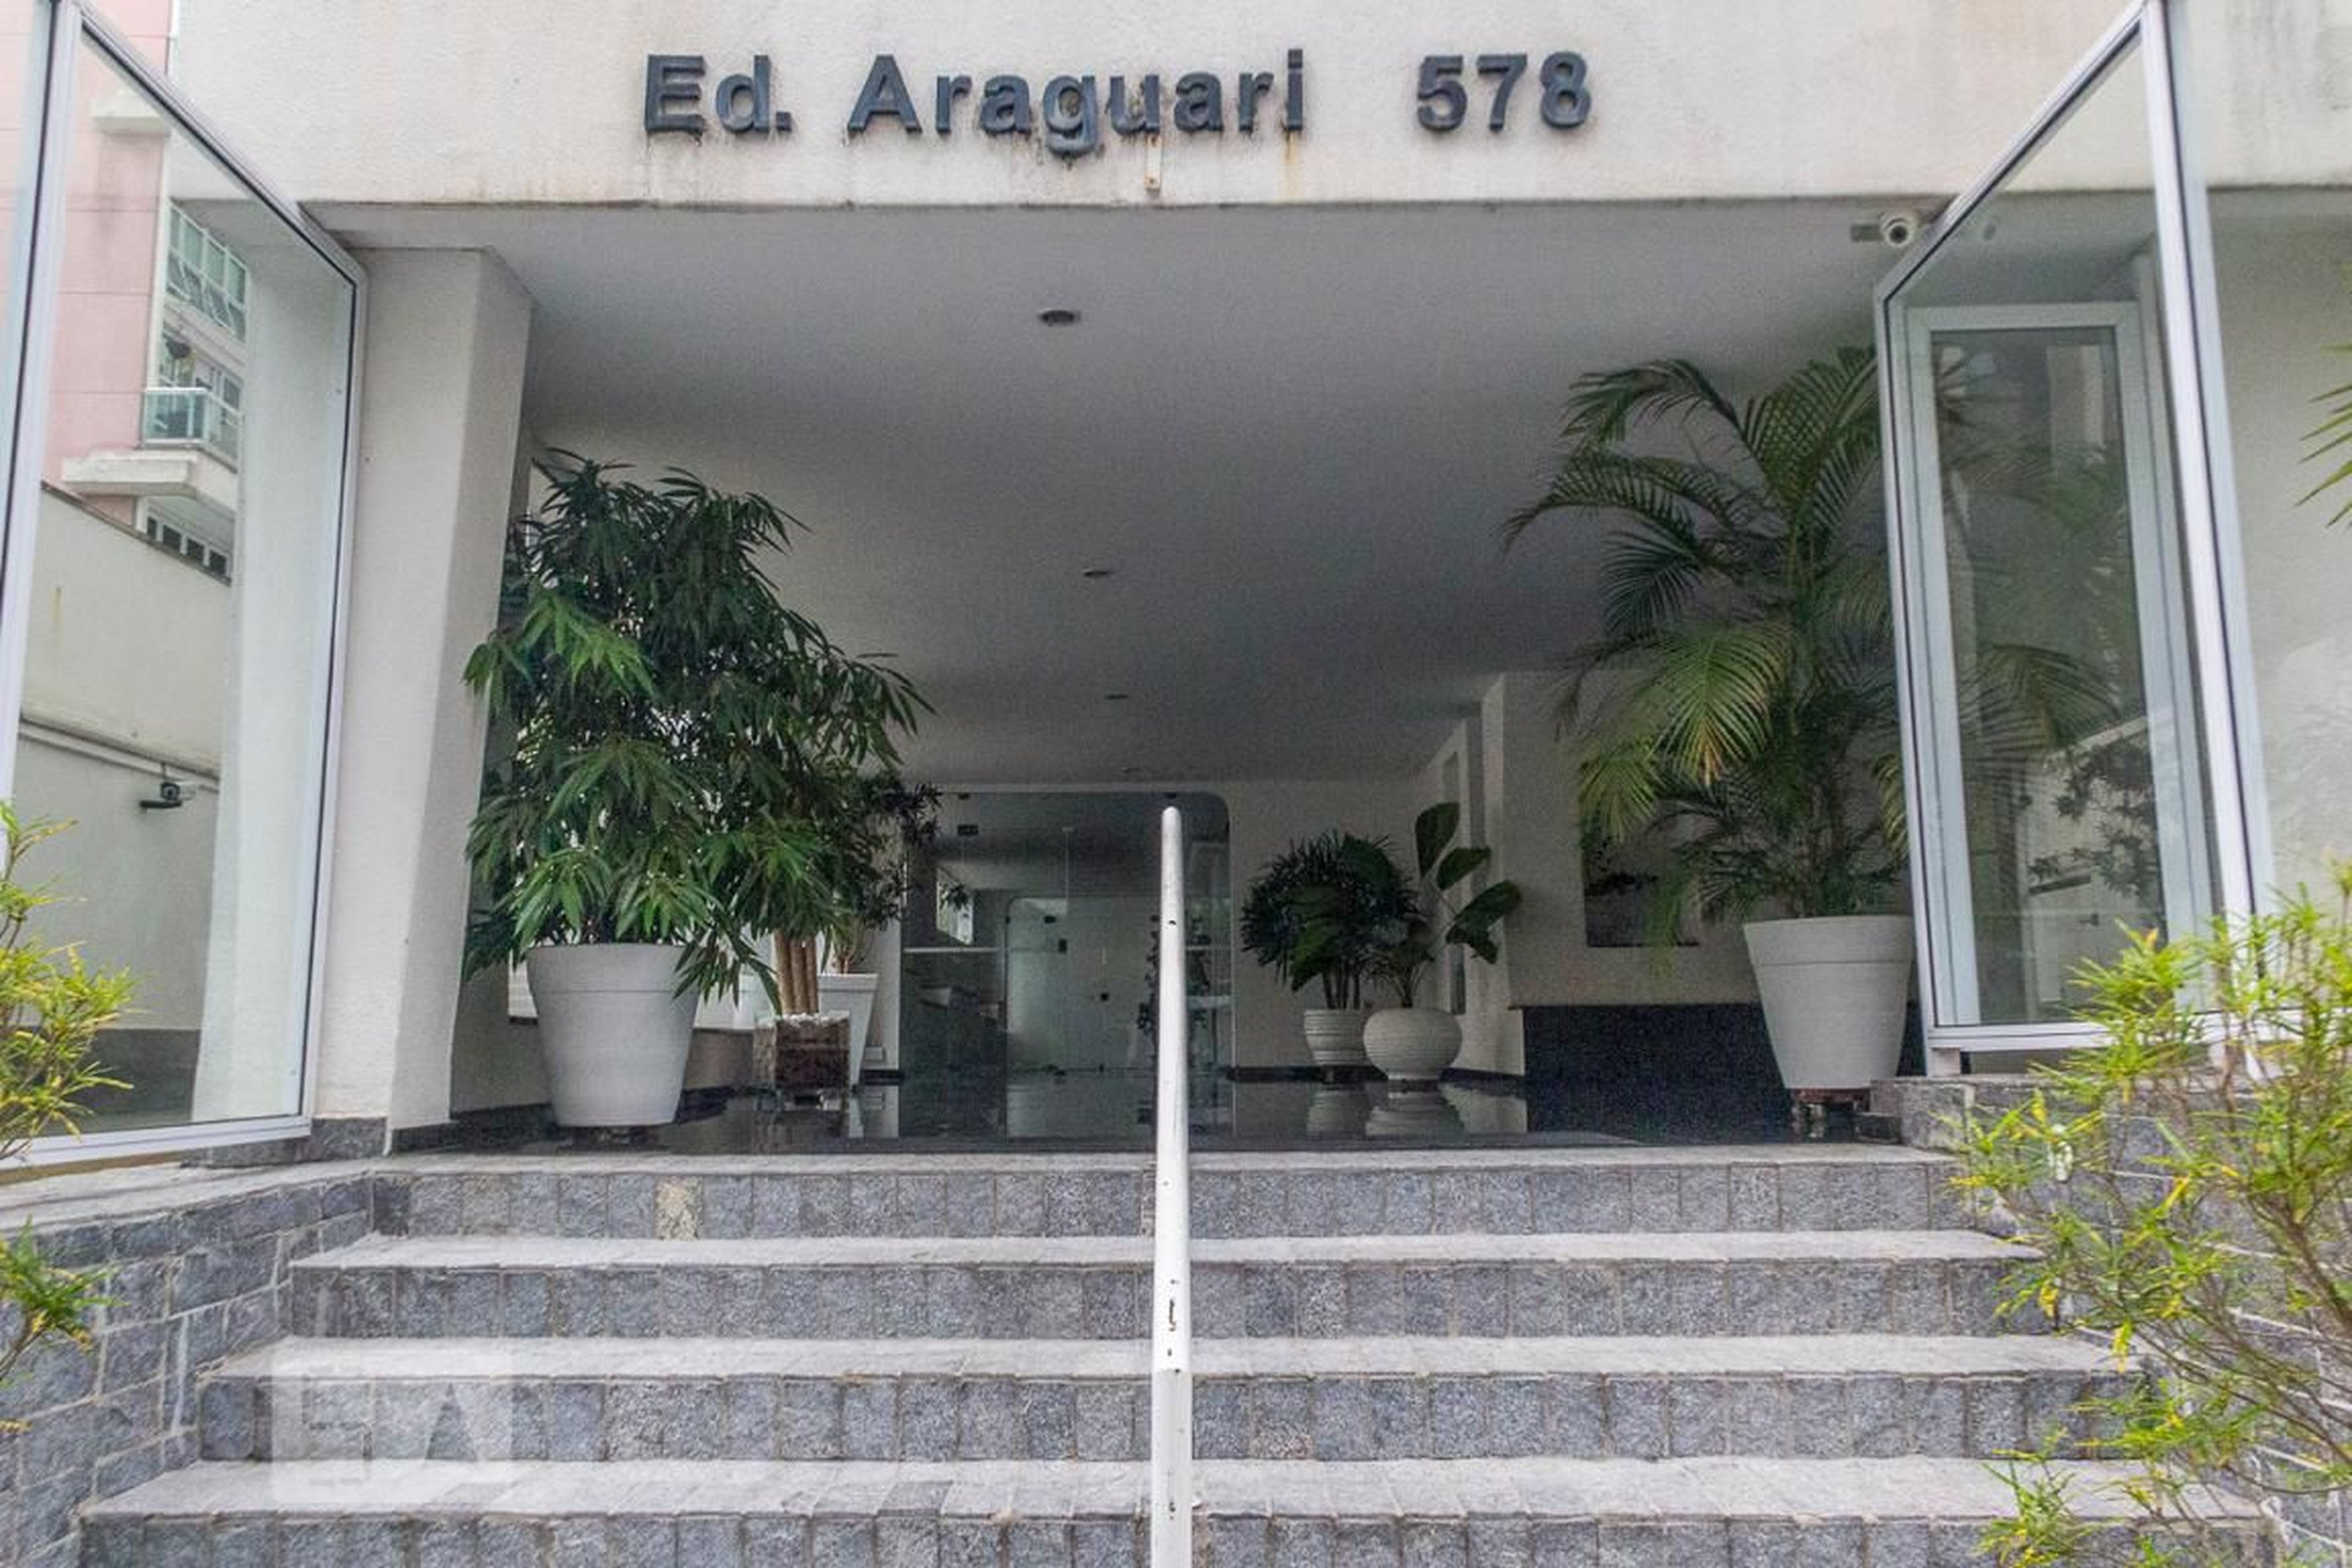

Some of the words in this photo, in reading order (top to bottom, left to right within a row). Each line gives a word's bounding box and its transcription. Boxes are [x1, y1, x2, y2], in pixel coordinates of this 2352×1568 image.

[644, 55, 793, 134] Ed.
[845, 48, 1306, 156] Araguari
[1416, 51, 1593, 132] 578
